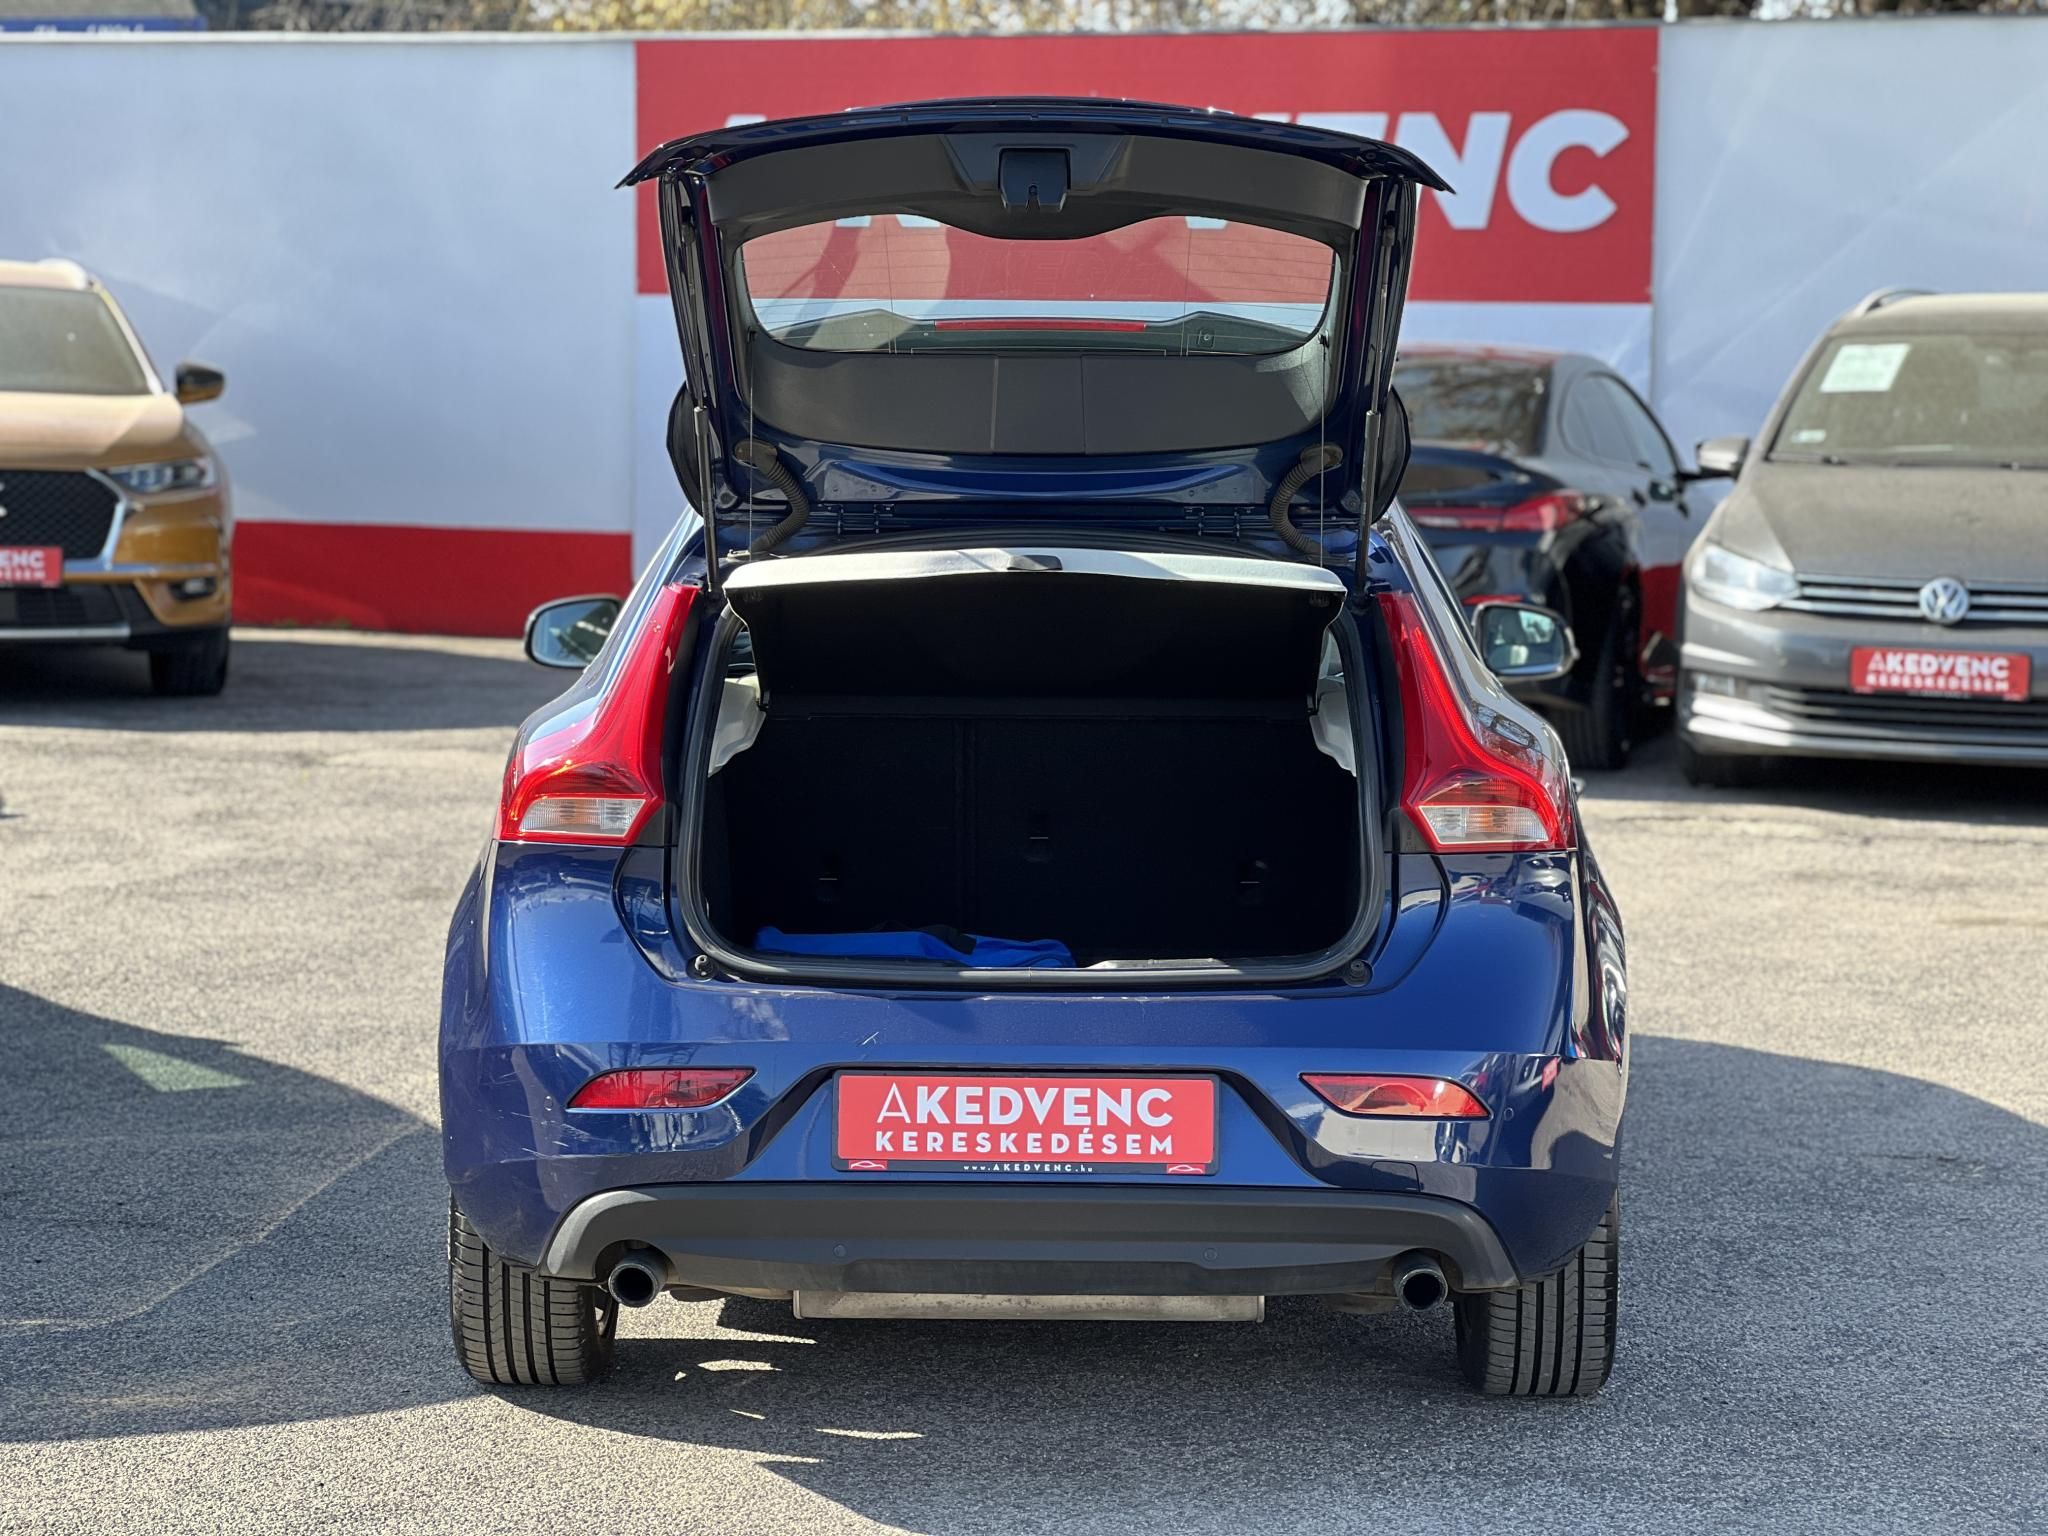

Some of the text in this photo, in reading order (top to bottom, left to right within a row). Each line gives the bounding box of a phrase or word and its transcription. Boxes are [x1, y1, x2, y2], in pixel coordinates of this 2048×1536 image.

[1868, 651, 2009, 678] AKEDVENC
[877, 1082, 1173, 1127] AKEDVENC
[876, 1128, 1173, 1155] KERESKEDÉSEM
